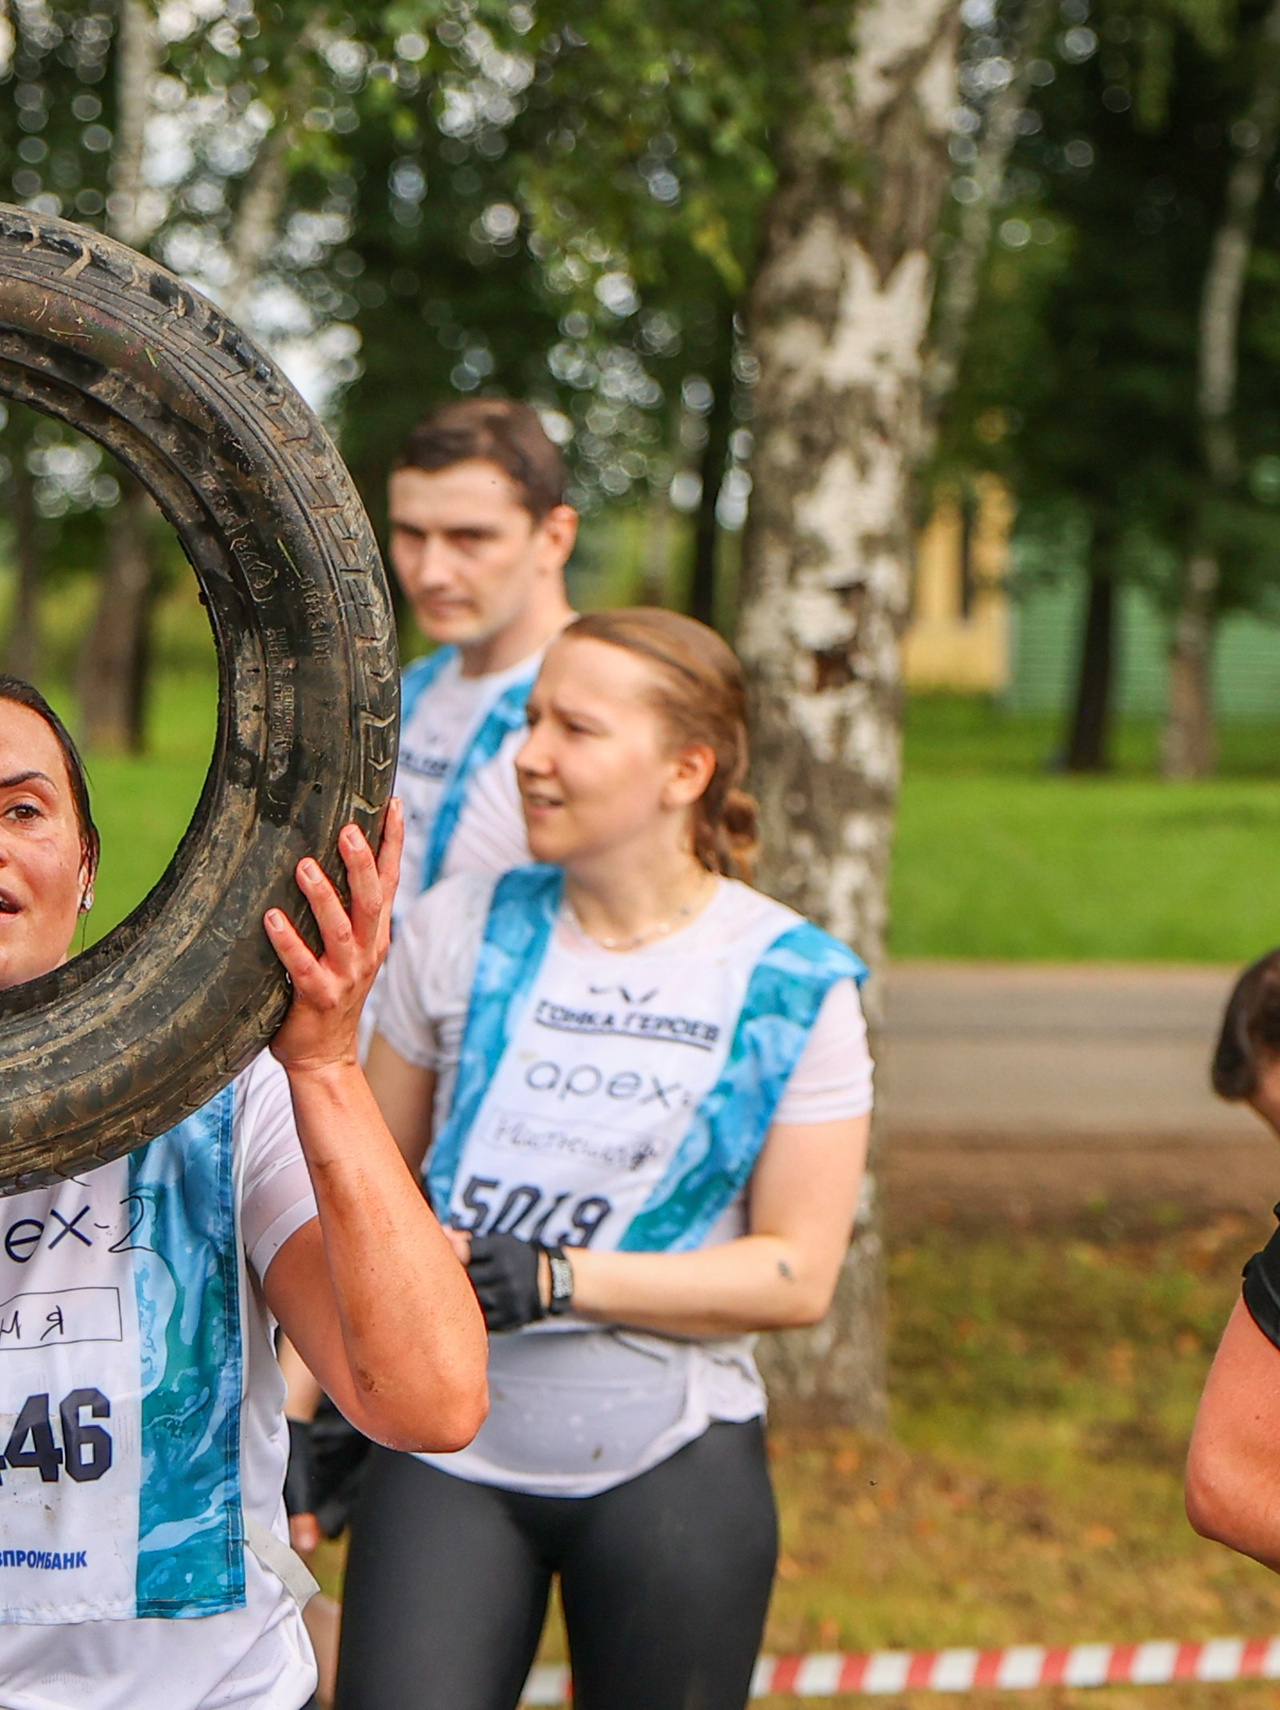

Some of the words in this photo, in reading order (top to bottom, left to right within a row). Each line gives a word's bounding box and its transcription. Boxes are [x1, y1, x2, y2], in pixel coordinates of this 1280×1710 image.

[536, 1000, 615, 1027] ГОНКА
[624, 1012, 720, 1042] ГЕРОЕВ
[451, 1175, 611, 1247] 5019
